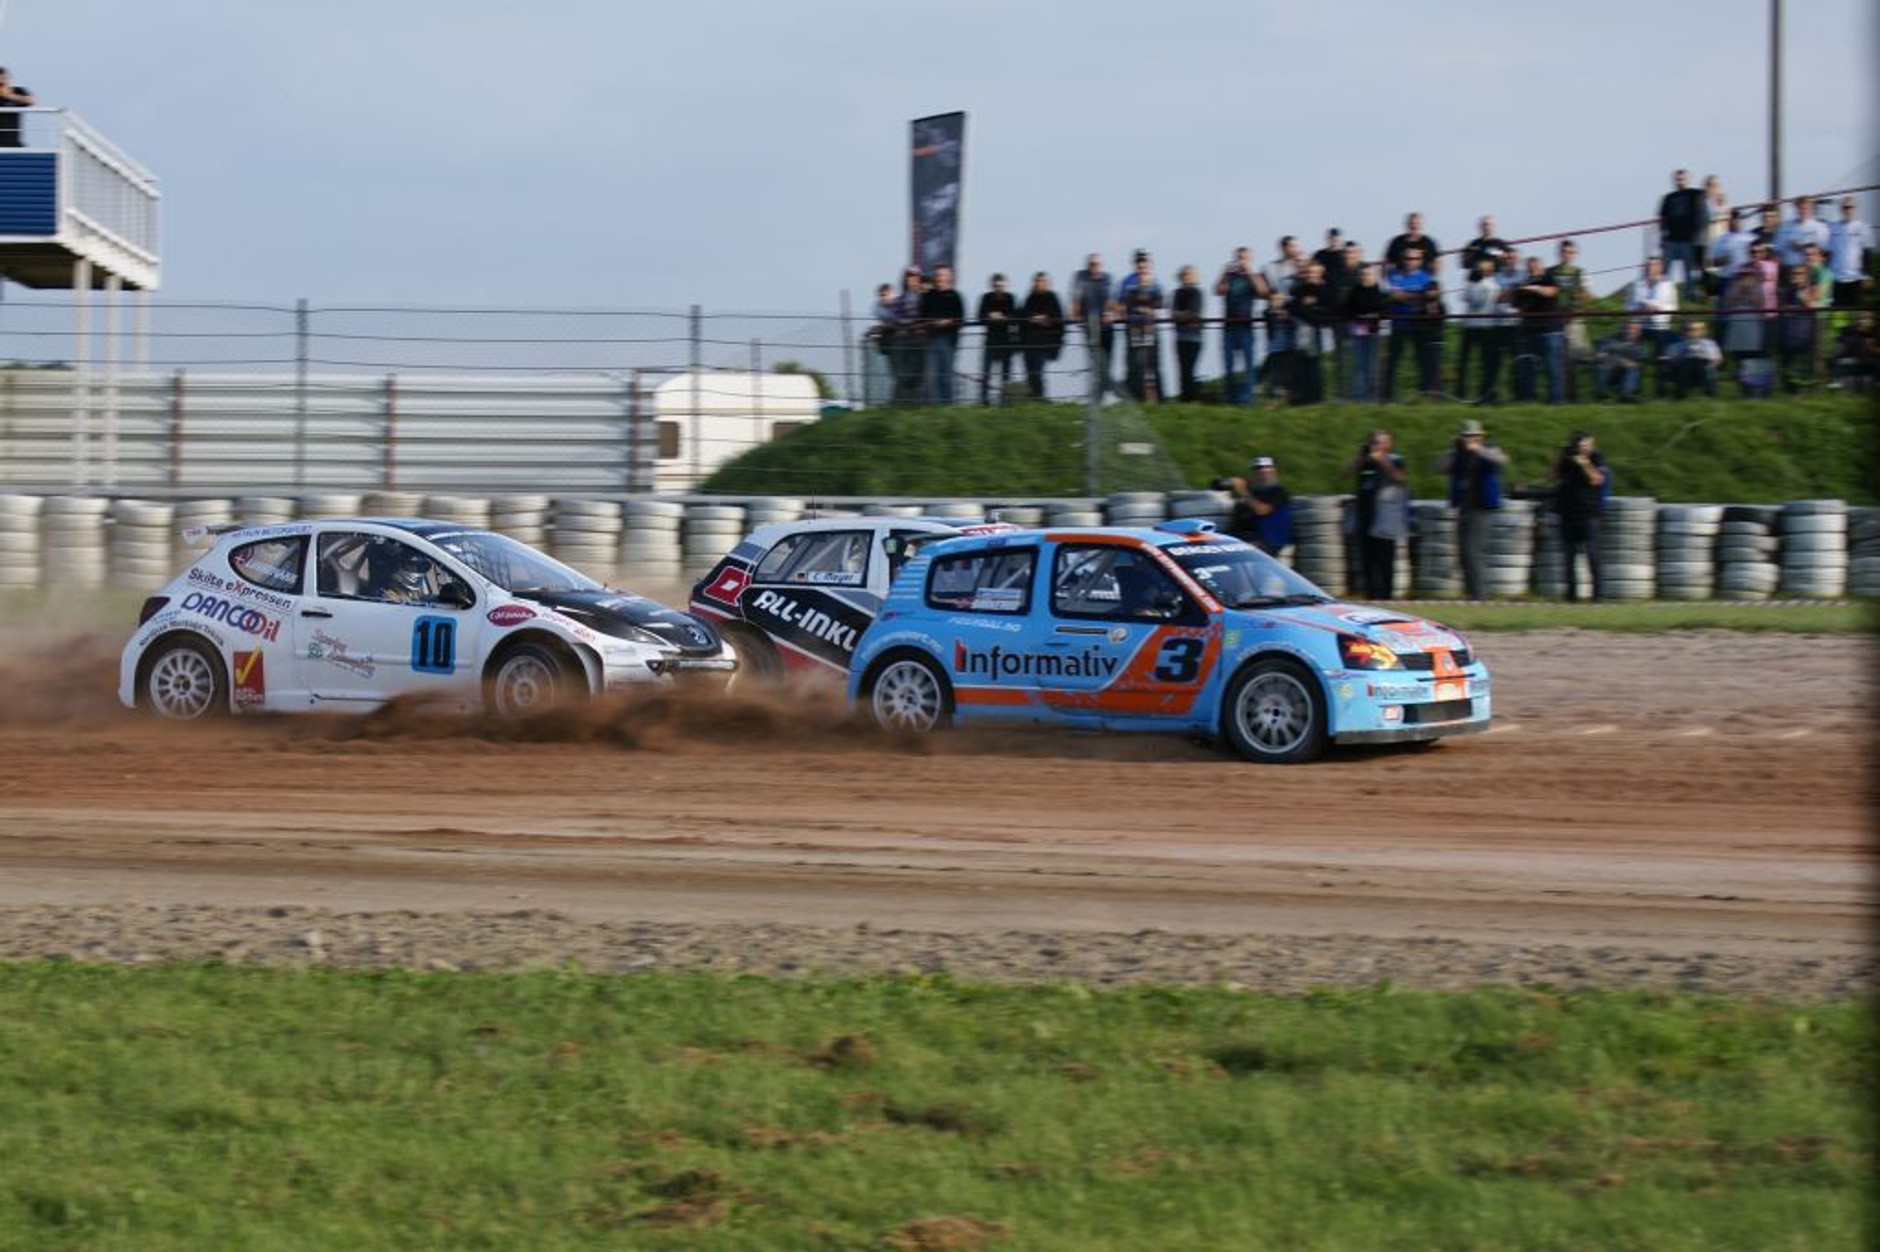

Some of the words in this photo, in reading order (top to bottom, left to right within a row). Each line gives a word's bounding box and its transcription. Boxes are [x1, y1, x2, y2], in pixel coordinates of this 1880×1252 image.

[188, 567, 224, 589] Skilte
[416, 621, 453, 669] 10
[1155, 637, 1205, 683] 3
